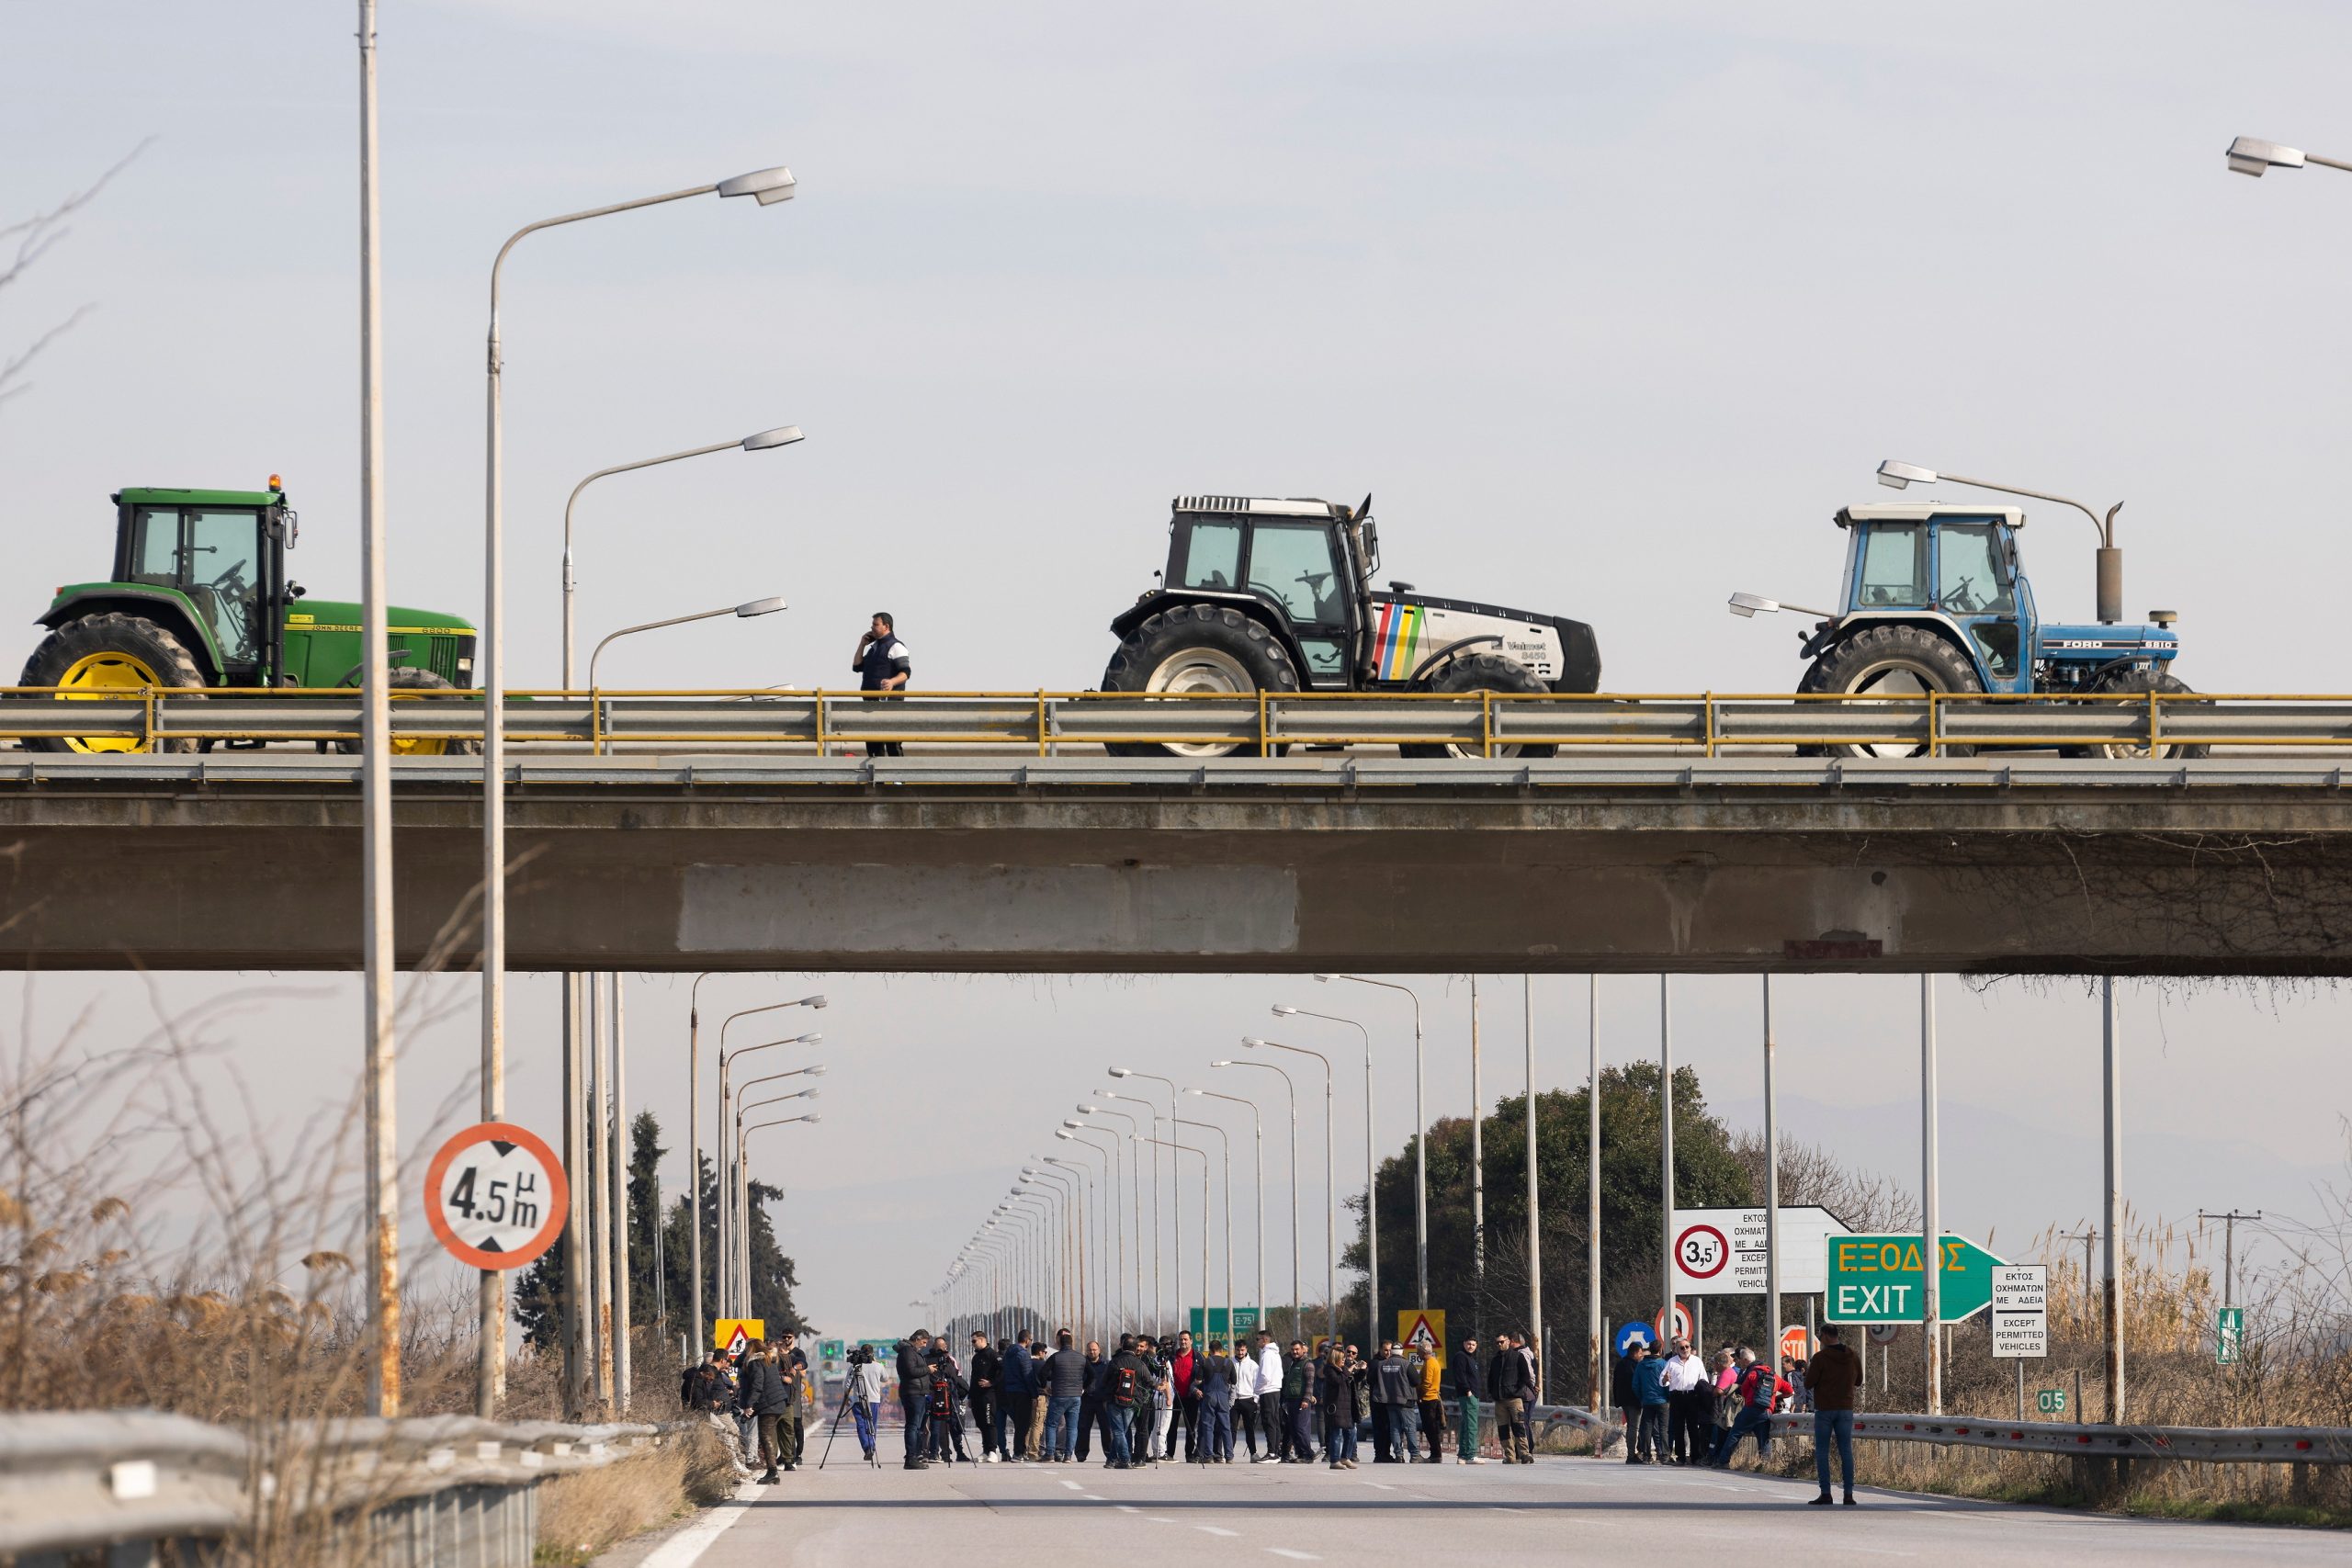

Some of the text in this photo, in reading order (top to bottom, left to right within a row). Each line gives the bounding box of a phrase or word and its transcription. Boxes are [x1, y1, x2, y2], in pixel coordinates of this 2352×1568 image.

[1507, 641, 1546, 650] Valmet
[1521, 652, 1546, 660] 8450
[449, 1167, 508, 1223] 4.5
[512, 1199, 537, 1229] m
[1734, 1227, 1767, 1235] ΟΧΗΜΑΤ
[1735, 1240, 1747, 1248] ΜΕ
[1741, 1254, 1767, 1262] EXCEP
[1735, 1267, 1767, 1275] PERMITT
[2006, 1272, 2033, 1280] ΕΚΤΟΣ
[1737, 1280, 1767, 1288] VEHICL
[1996, 1284, 2043, 1292] ΟΧΗΜΑΤΩΝ
[1838, 1285, 1912, 1314] EXIT
[1996, 1296, 2043, 1304] ΜΕ ΑΔΕΙΑ
[2003, 1319, 2036, 1327] EXCEPT
[1781, 1339, 1808, 1361] STO
